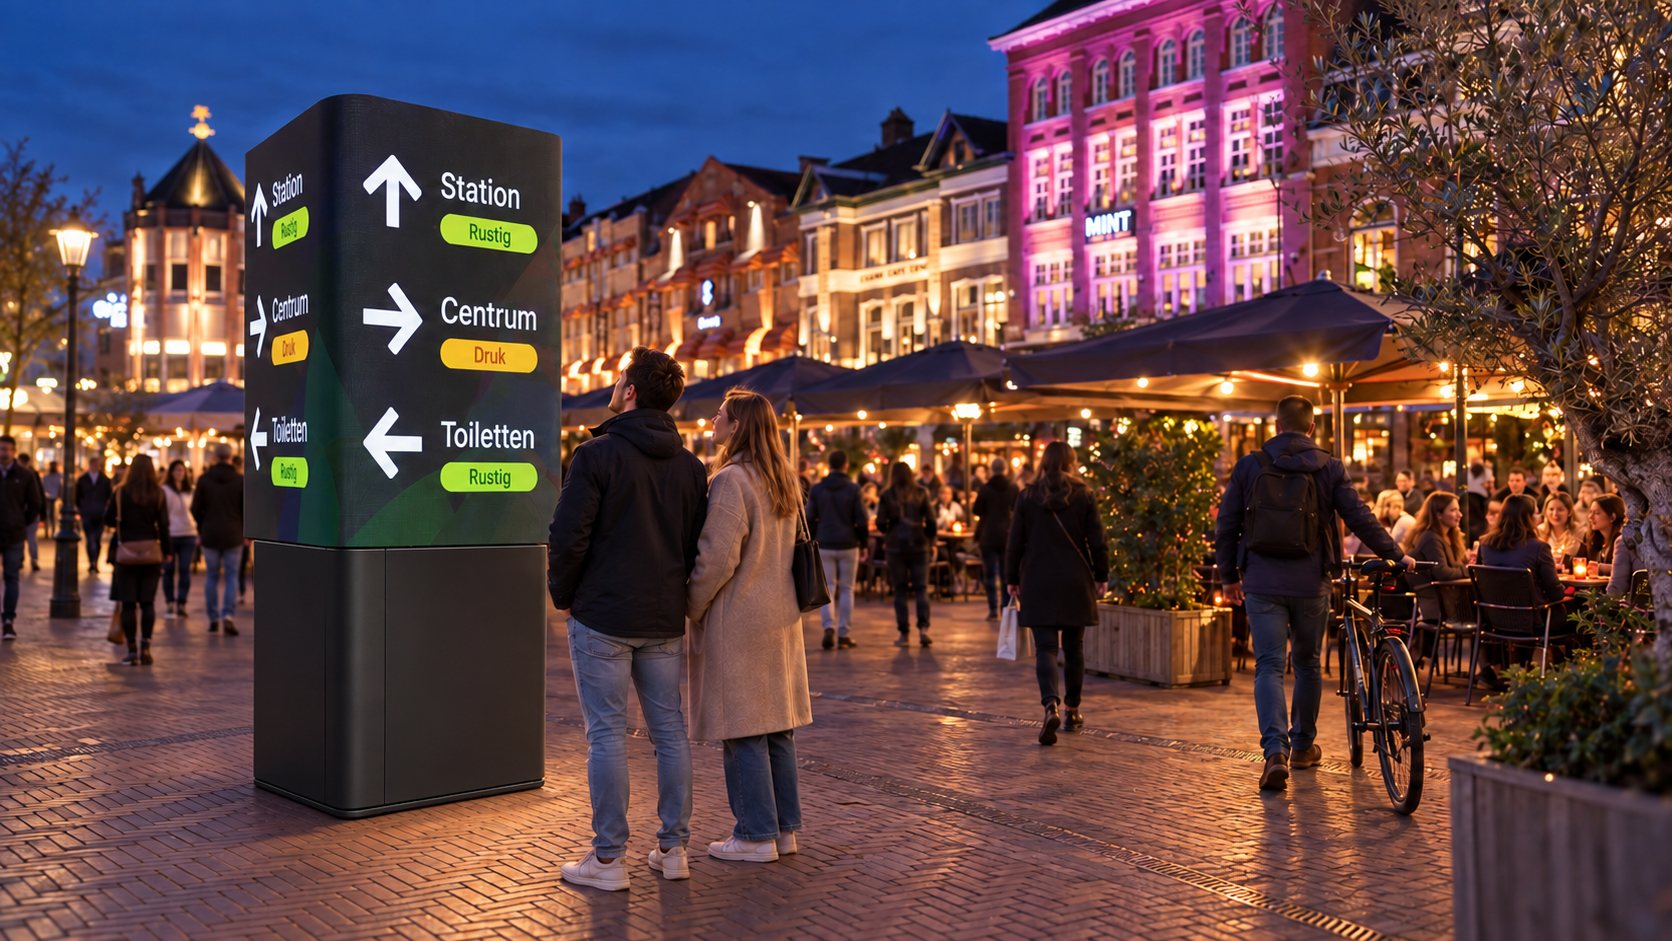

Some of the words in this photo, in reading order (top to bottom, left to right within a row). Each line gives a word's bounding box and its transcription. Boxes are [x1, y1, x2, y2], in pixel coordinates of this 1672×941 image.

[272, 173, 303, 208] Station
[441, 171, 520, 210] Station
[281, 217, 297, 239] Rustig
[469, 223, 511, 248] Rustig
[1085, 210, 1132, 238] MINT
[272, 293, 309, 323] Centrum
[441, 296, 537, 331] Centrum
[282, 338, 296, 357] Druk
[474, 347, 506, 365] Druk
[271, 416, 308, 443] Toiletten
[441, 421, 535, 449] Toiletten
[280, 463, 297, 484] Rustig
[469, 468, 511, 489] Rustig
